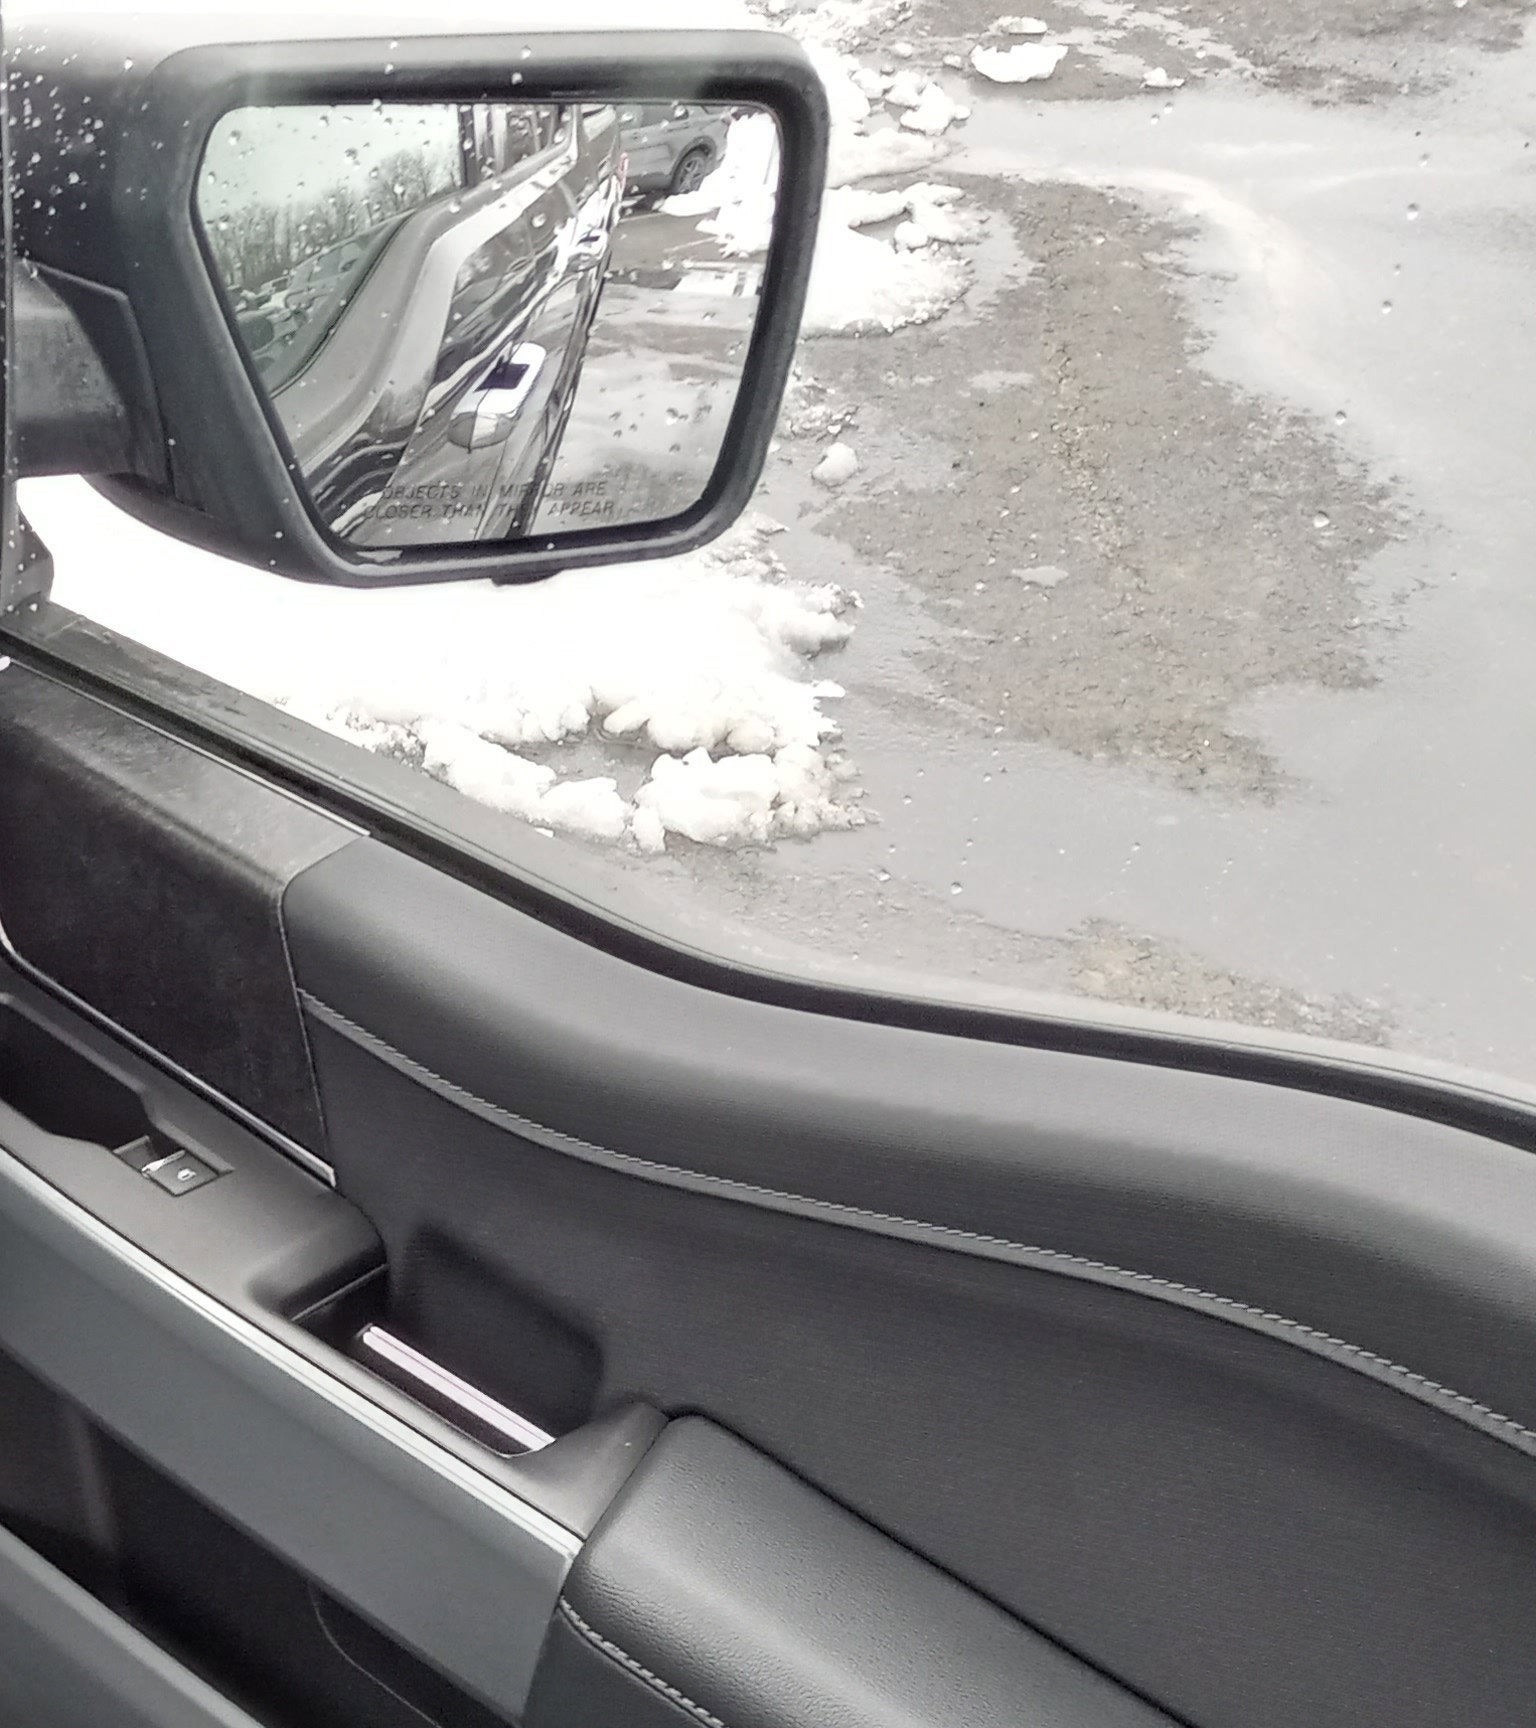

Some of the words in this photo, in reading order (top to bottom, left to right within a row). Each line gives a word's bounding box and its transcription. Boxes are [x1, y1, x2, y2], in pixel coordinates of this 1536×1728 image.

[381, 483, 459, 500] OBJECTS
[499, 482, 563, 500] MIROR
[573, 482, 607, 497] ARE
[547, 502, 614, 517] APPEAR
